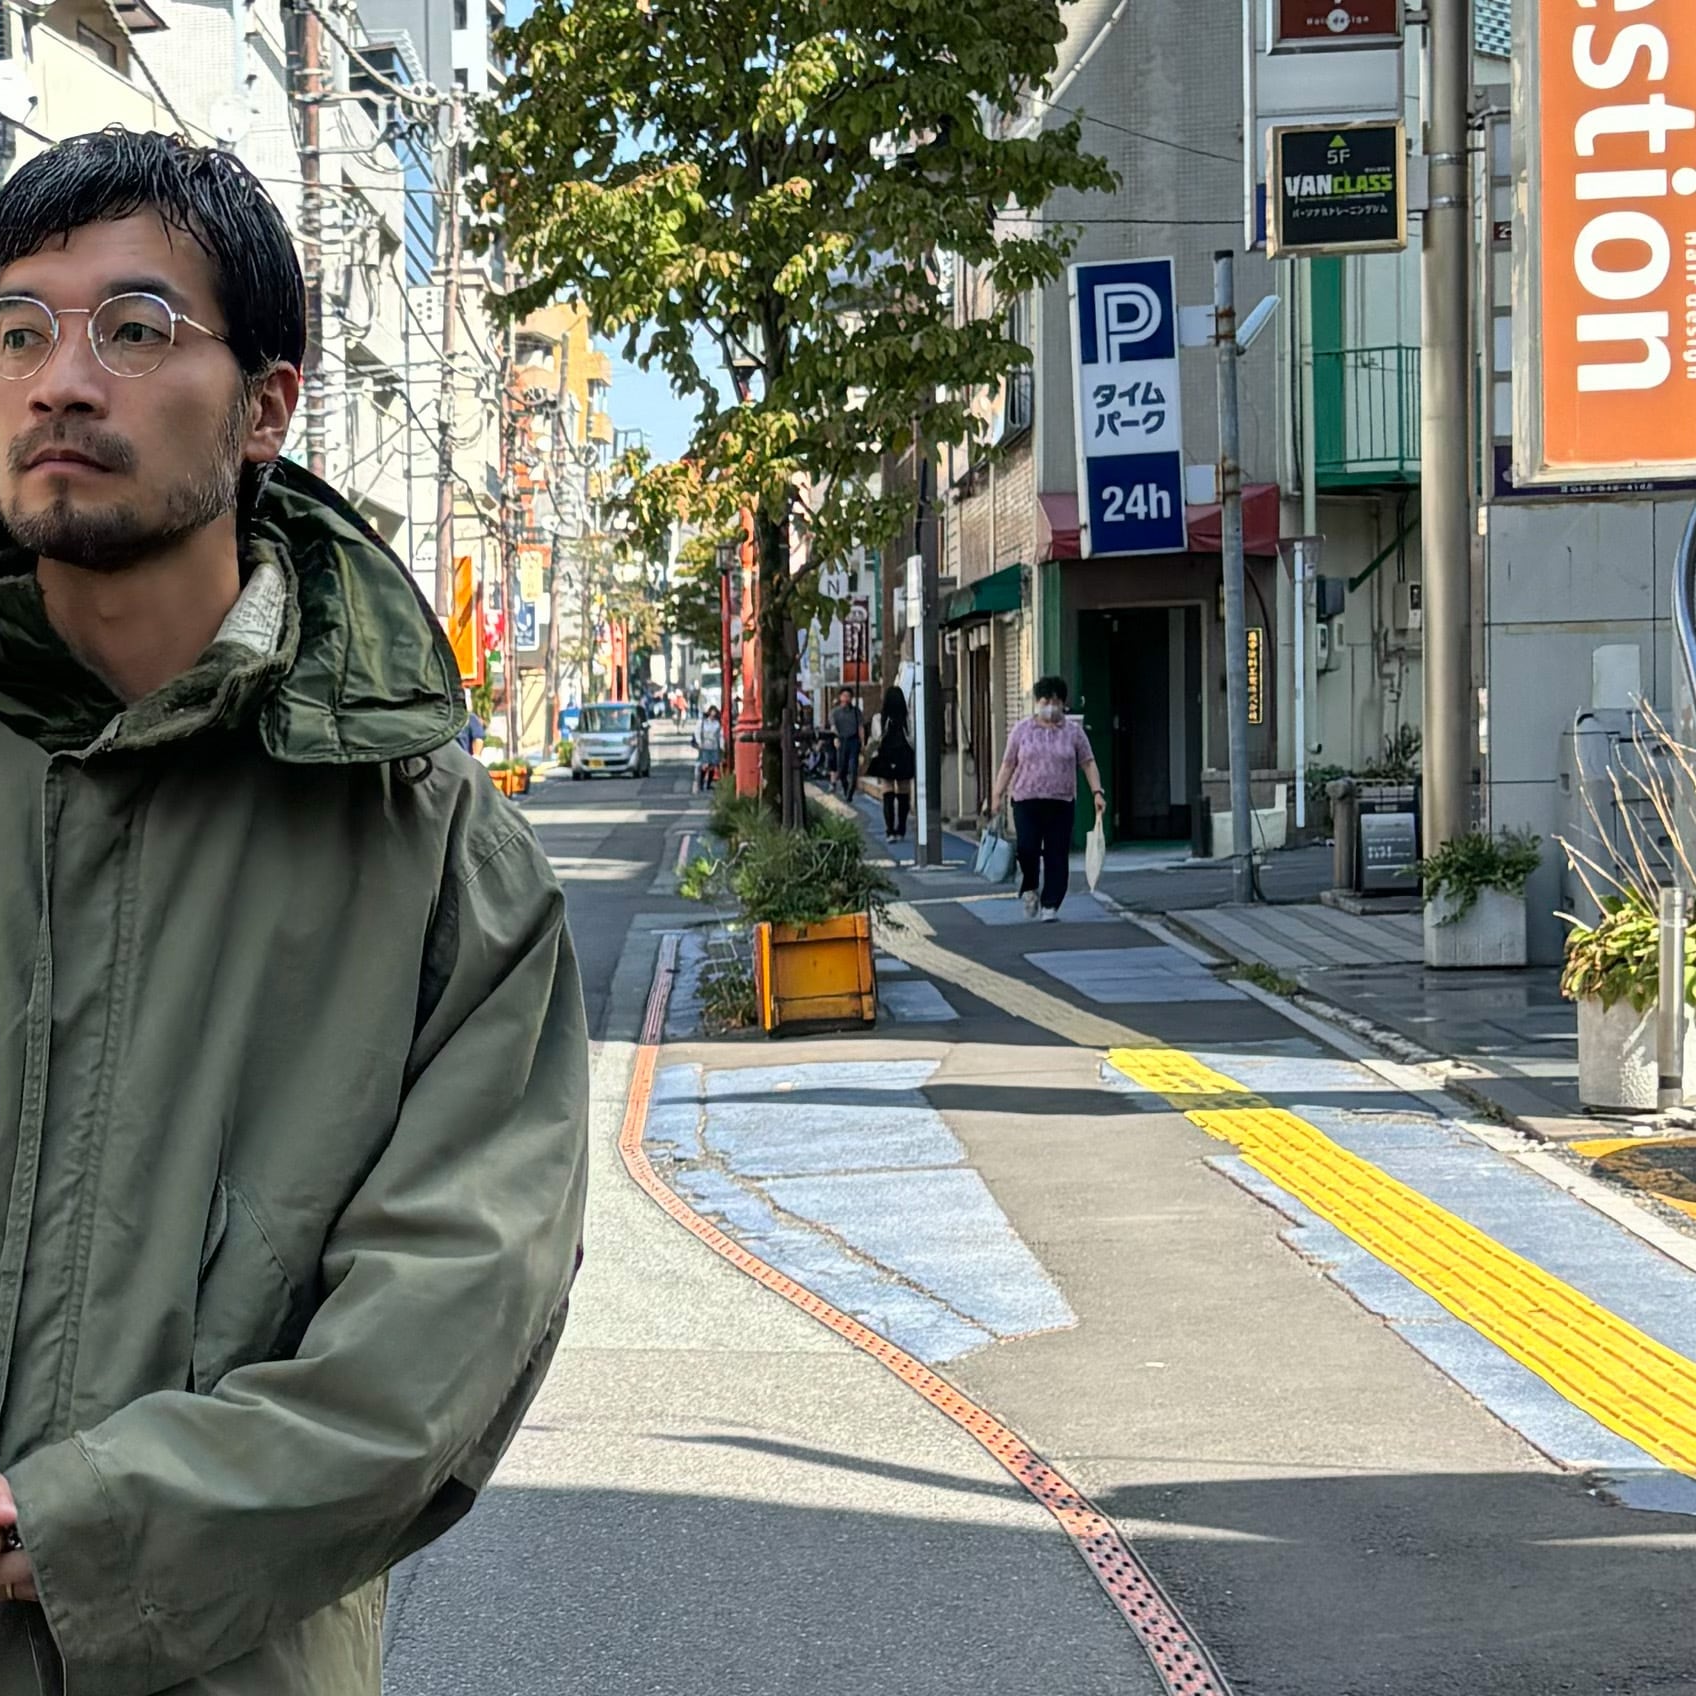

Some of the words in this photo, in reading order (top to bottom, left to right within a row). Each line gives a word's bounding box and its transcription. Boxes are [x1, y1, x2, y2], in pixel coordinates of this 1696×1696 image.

[1327, 149, 1351, 165] 5F
[1572, 0, 1696, 392] stion
[1093, 282, 1162, 364] P
[1093, 381, 1165, 409] タイム
[1095, 410, 1165, 438] パーク
[1102, 483, 1171, 522] 24h
